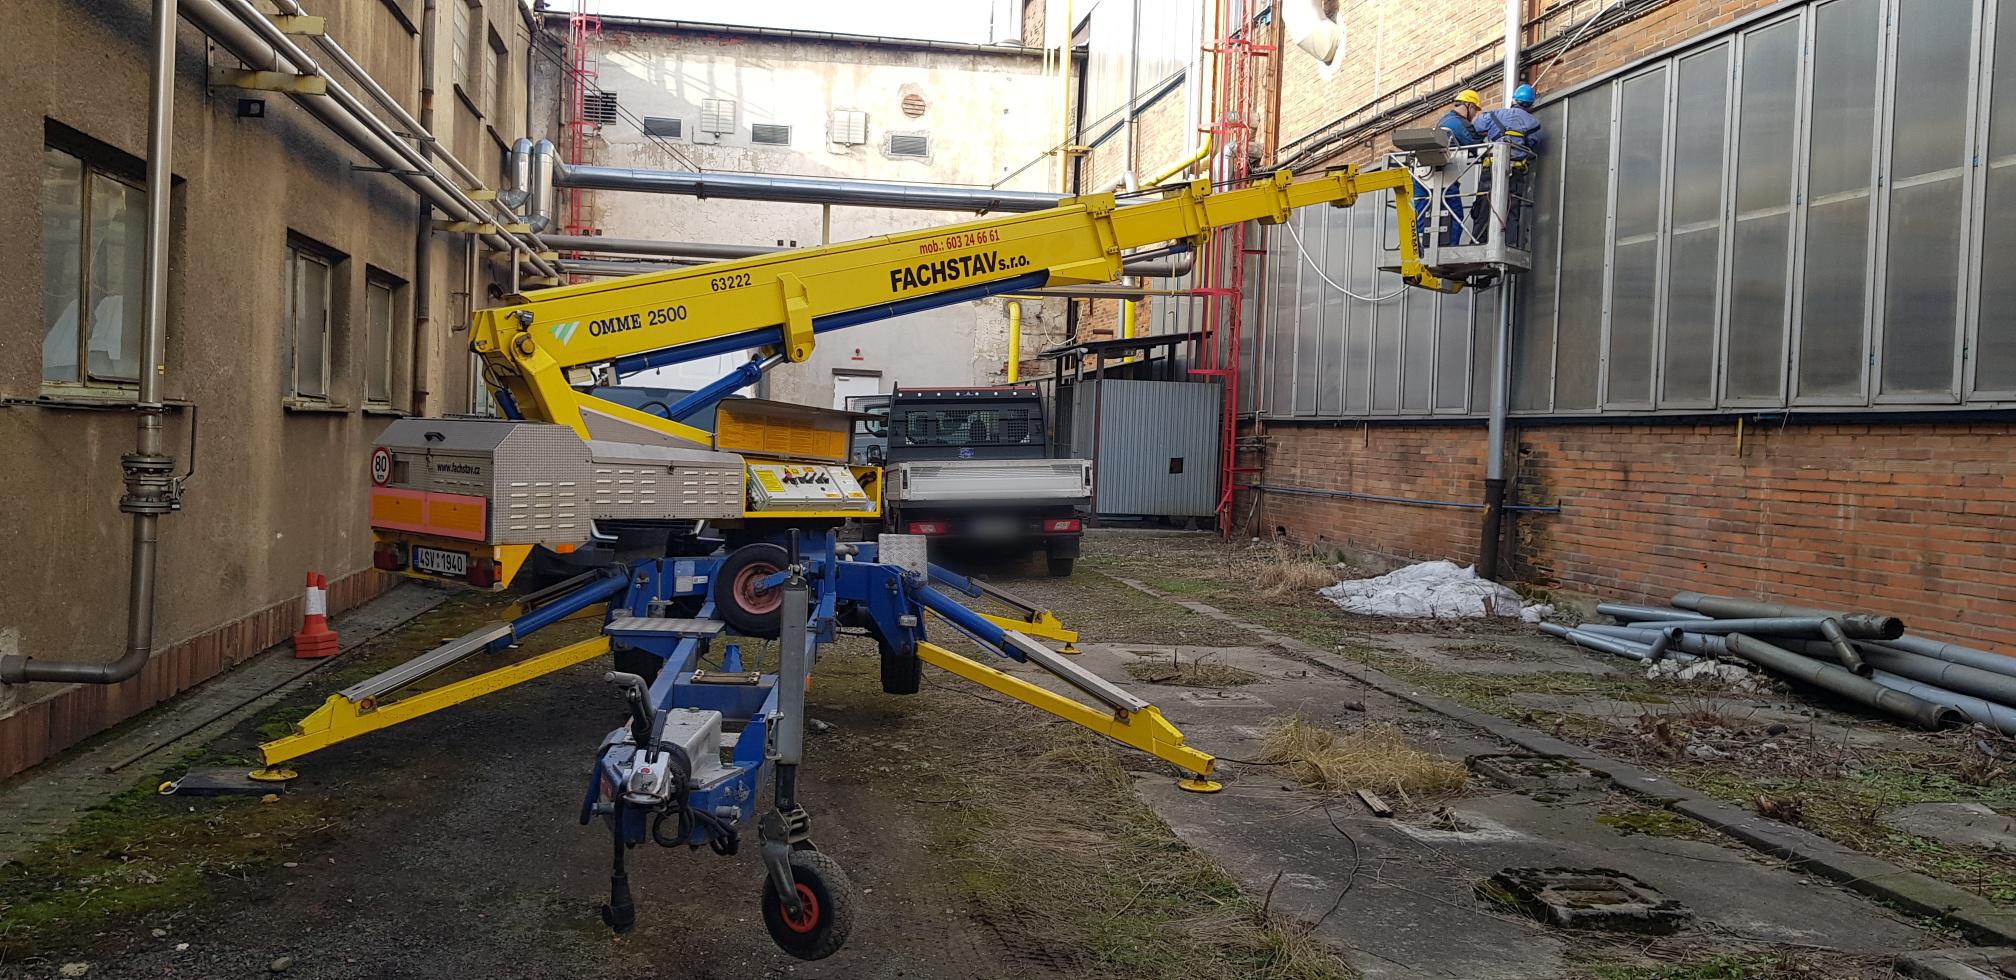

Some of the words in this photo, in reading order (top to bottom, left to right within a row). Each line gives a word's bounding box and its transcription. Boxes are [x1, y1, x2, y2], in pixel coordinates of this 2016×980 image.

[919, 240, 944, 255] mob.:
[946, 236, 962, 250] 603
[964, 234, 975, 246] 24
[977, 231, 987, 244] 66
[989, 229, 1000, 242] 61
[711, 273, 751, 292] 63222
[890, 251, 998, 292] FACHSTAV
[998, 254, 1030, 271] s.r.o.
[589, 313, 641, 337] OMME
[648, 305, 687, 326] 2500
[375, 456, 387, 472] 80
[437, 462, 480, 475] www.fachstav.cz
[420, 549, 435, 568] 4SV
[442, 553, 463, 573] 1940
